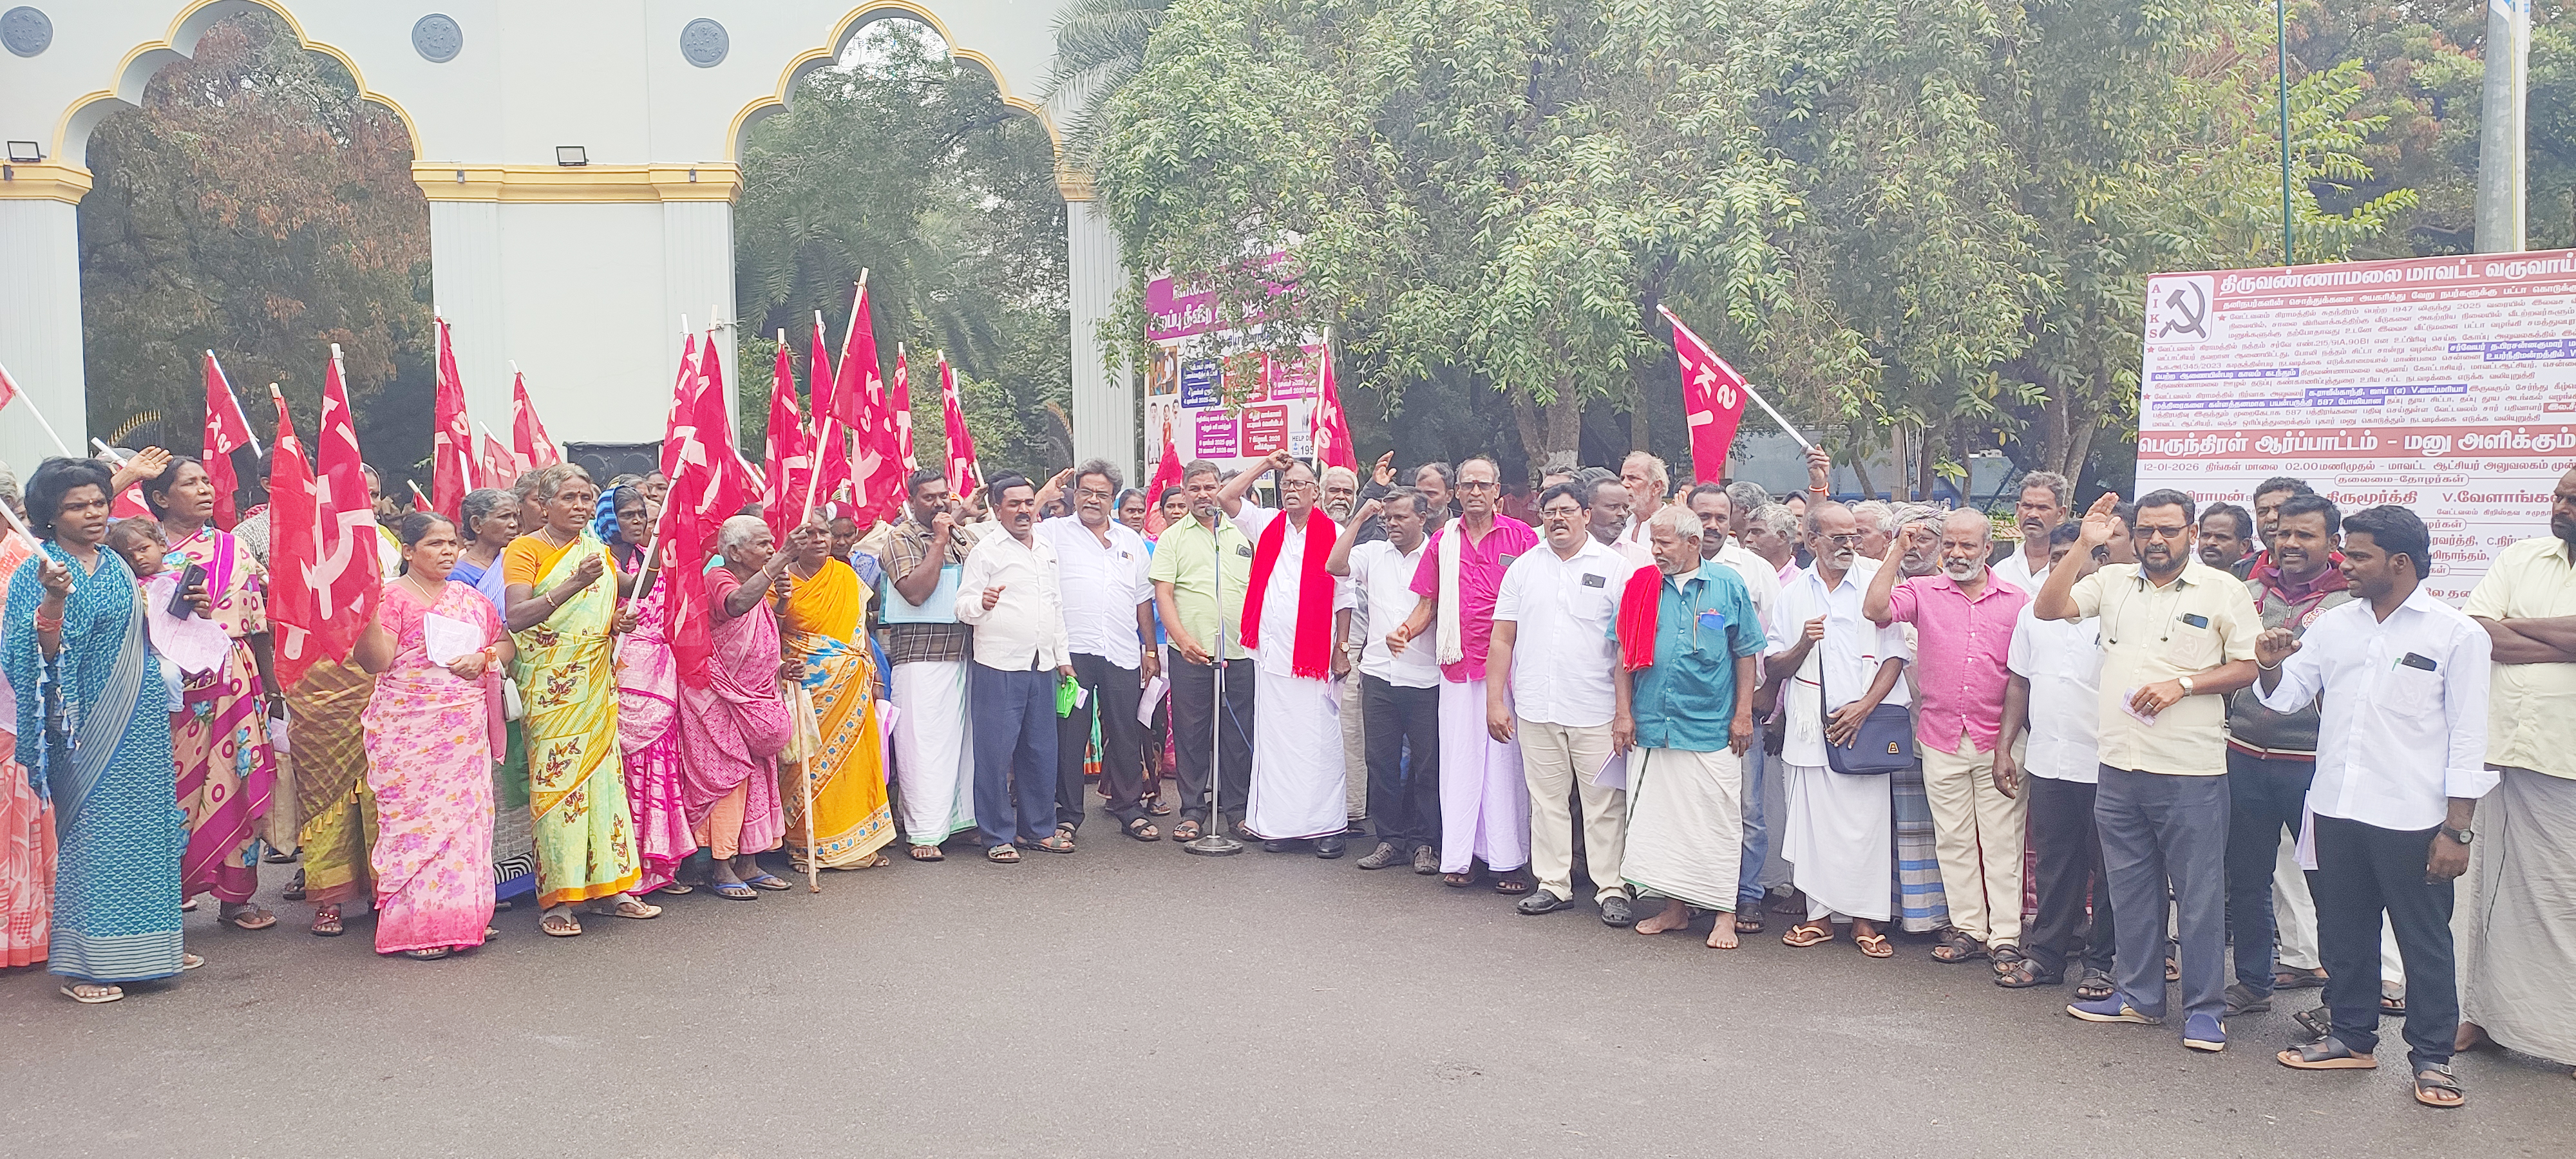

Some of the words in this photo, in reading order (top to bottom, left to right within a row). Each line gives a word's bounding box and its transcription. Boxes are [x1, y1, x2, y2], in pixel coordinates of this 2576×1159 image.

[2219, 269, 2402, 296] திருவண்ணாமலை
[2406, 258, 2480, 281] மாவட்ட
[2138, 431, 2249, 457] பெருந்திரள்
[2255, 429, 2378, 455] ஆர்ப்பாட்டம்
[2404, 435, 2452, 457] மனு
[2458, 426, 2576, 452] அளிக்கும்
[2143, 463, 2199, 471] 12-01-2026
[2204, 461, 2242, 473] திங்கள்
[2433, 459, 2480, 471] ஆட்சியர்
[2483, 458, 2548, 473] அலுவலகம்
